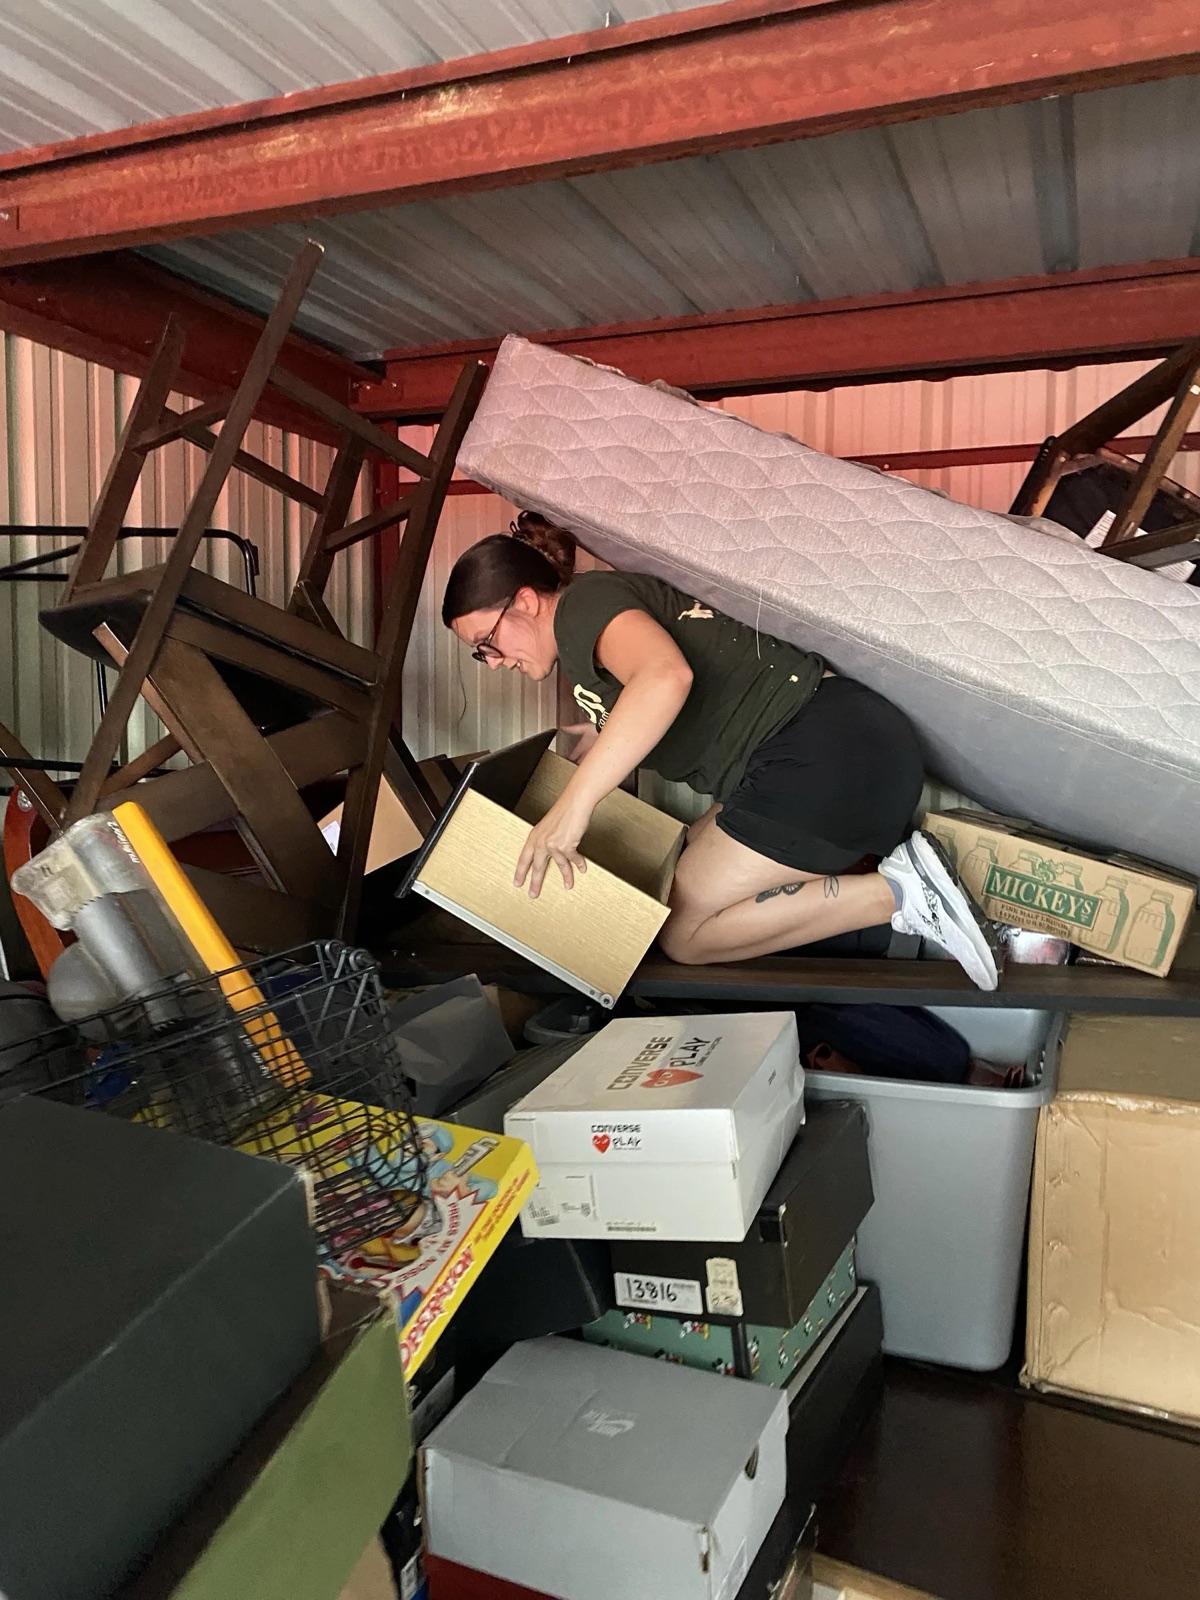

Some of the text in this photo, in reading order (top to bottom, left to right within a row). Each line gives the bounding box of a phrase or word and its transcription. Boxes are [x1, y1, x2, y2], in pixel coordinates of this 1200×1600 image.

[607, 1036, 674, 1090] CONVERSE
[669, 1037, 710, 1067] PLAY
[591, 1124, 642, 1133] CONVERSE
[612, 1136, 642, 1148] PLAY
[626, 1278, 677, 1302] 13816
